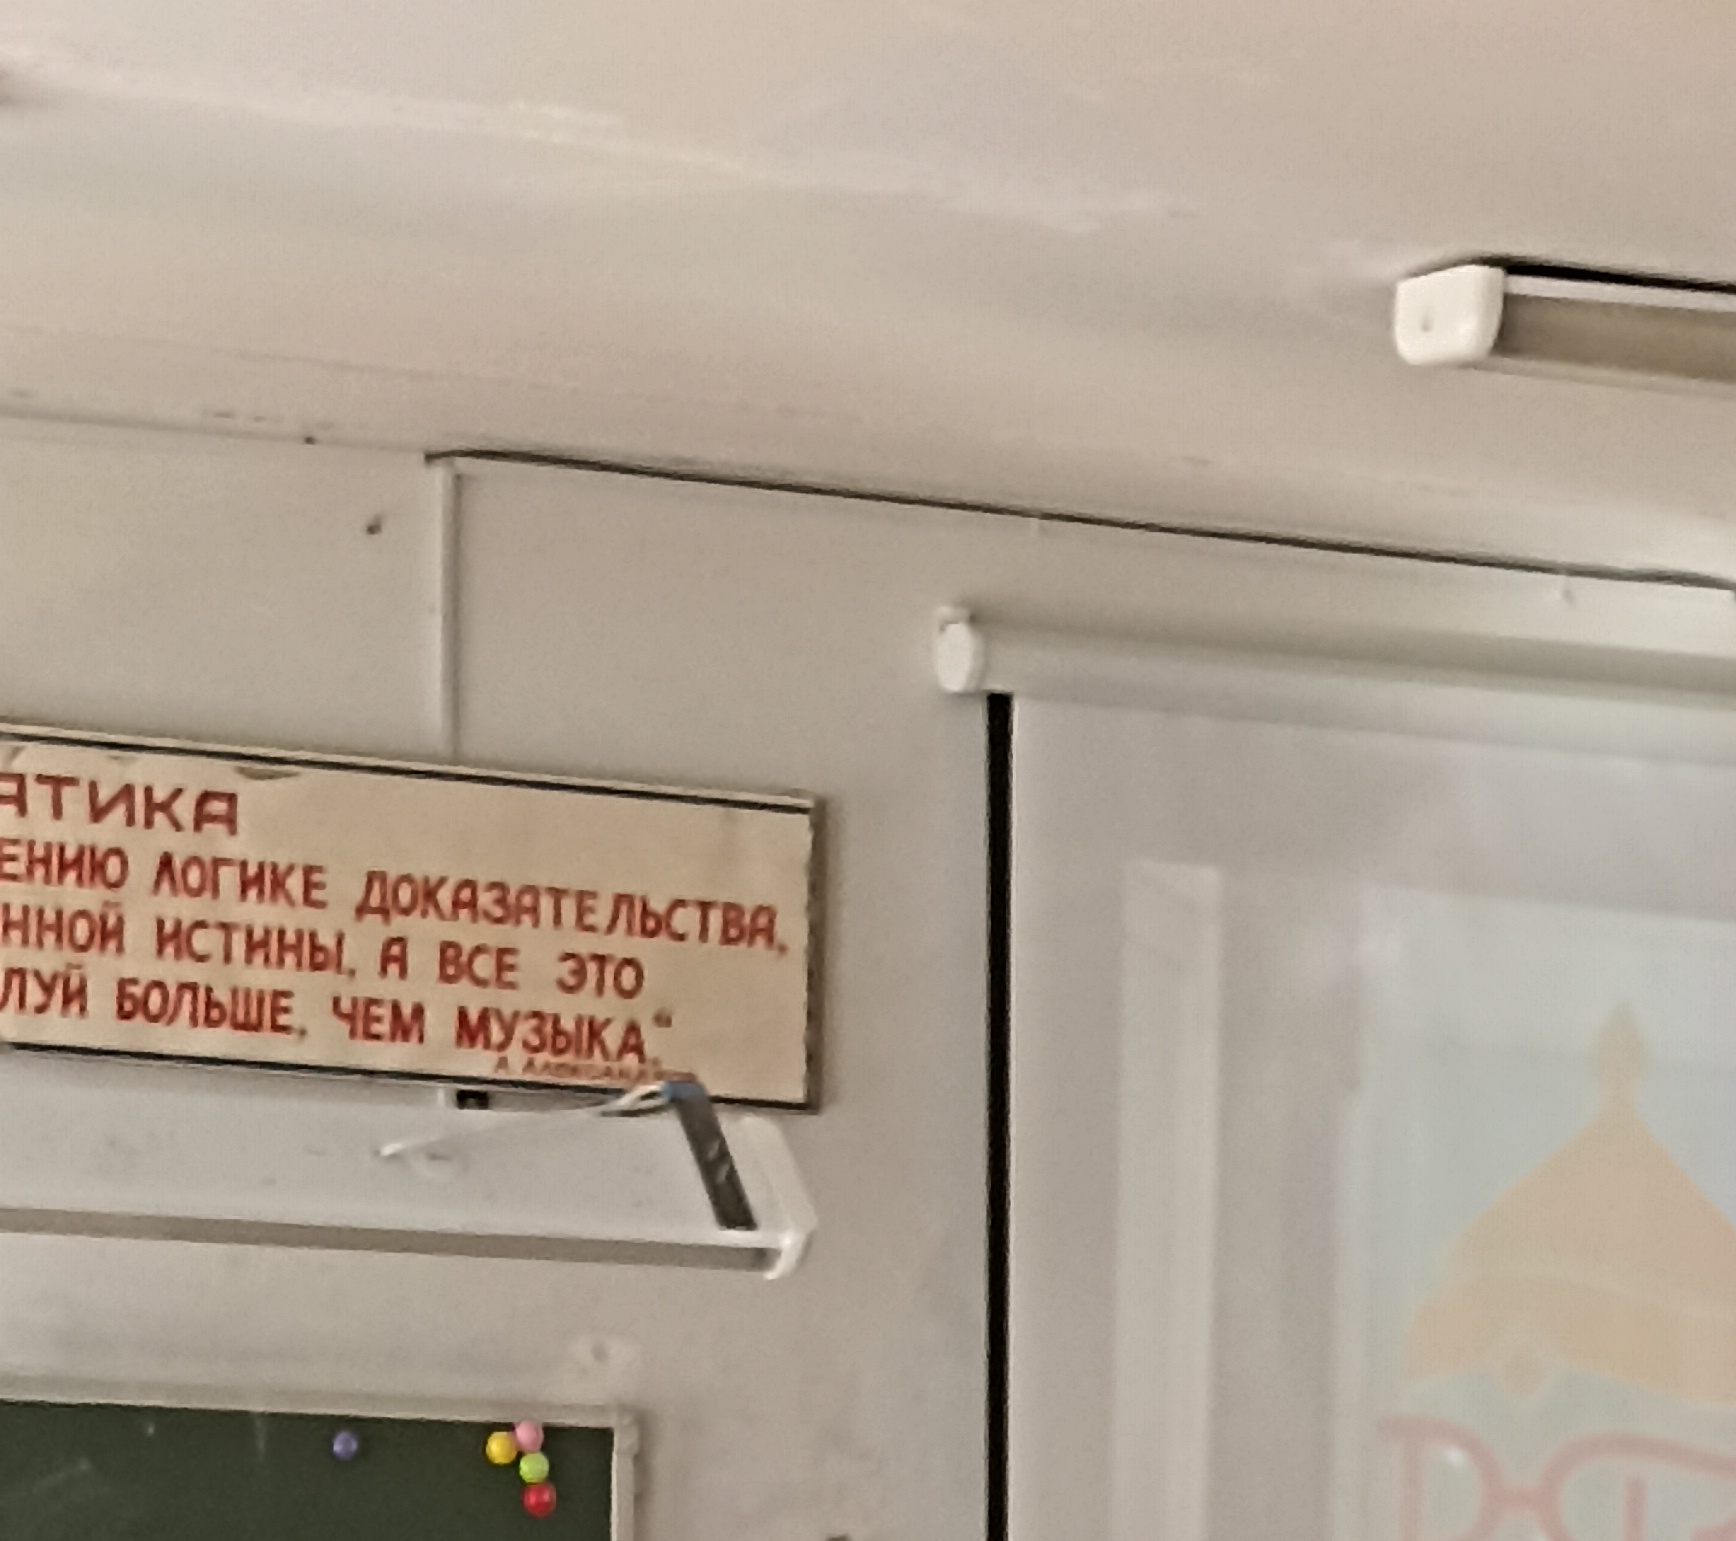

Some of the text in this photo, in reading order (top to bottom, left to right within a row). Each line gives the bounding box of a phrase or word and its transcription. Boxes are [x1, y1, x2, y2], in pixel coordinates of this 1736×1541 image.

[0, 836, 789, 960] ЕНИЮ ЛОГИКЕ ДОКАЗАТЕЛЬСТВА,
[0, 900, 126, 958] ННОЙ
[379, 935, 410, 980] А
[437, 939, 519, 991] ВСЕ
[556, 951, 645, 1000] ЭТО
[0, 963, 89, 1019] ЛУЙ
[332, 995, 426, 1045] ЧЕМ
